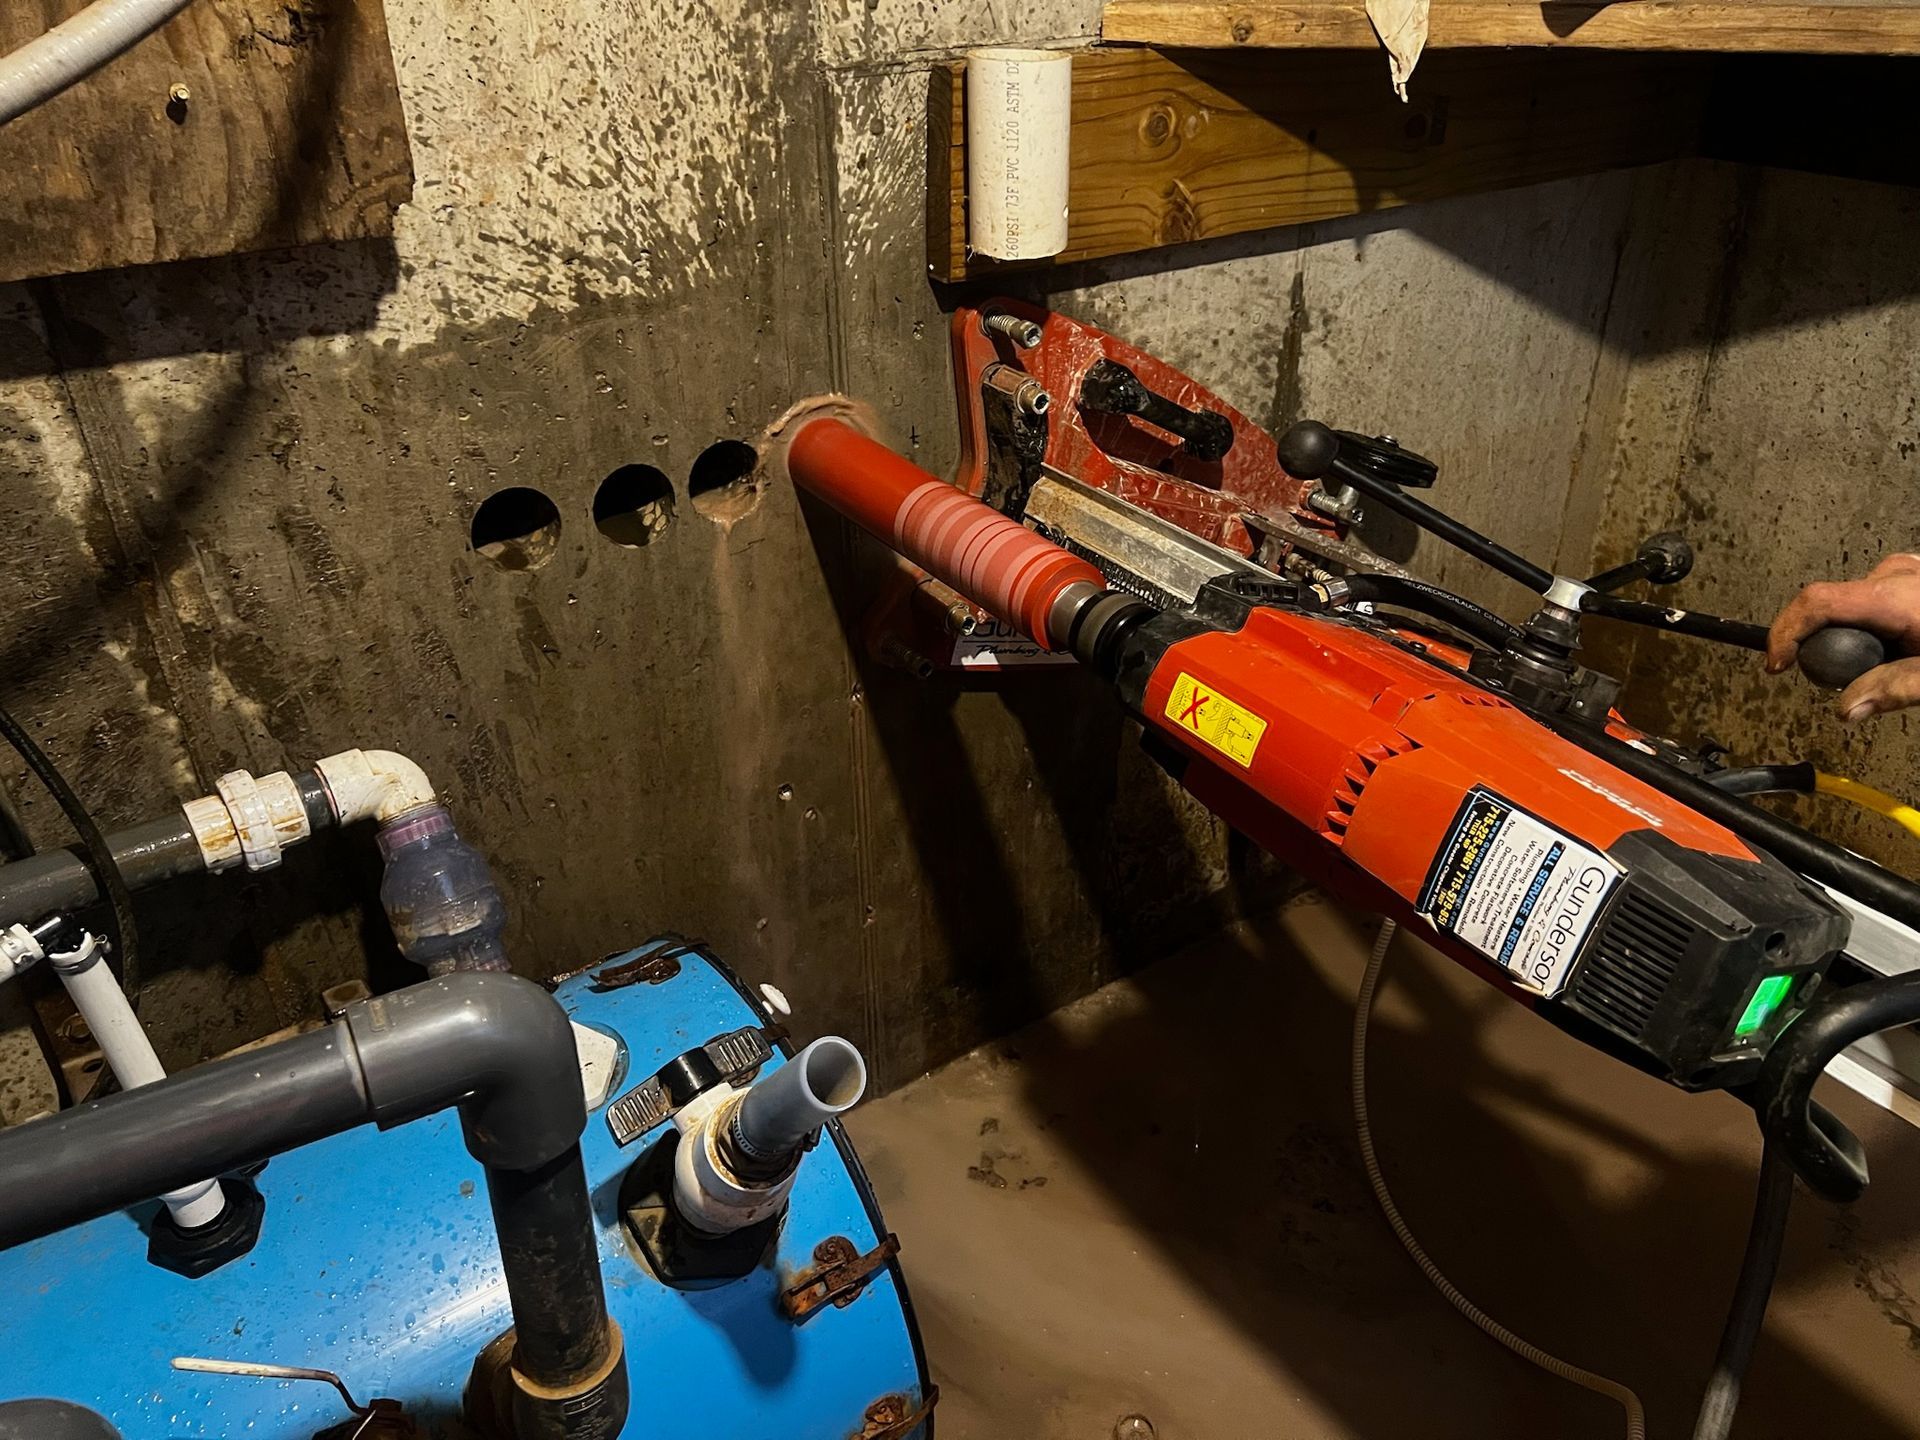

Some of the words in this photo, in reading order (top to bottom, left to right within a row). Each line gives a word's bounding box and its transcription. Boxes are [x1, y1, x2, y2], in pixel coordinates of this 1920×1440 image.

[1006, 82, 1019, 113] ASTM
[1006, 157, 1019, 180] PVC
[1006, 217, 1019, 258] 260PSI
[1460, 806, 1499, 870] 715-225-2861
[1502, 819, 1515, 837] New
[1475, 838, 1504, 888] Construction
[1486, 846, 1511, 887] Decorative
[1519, 842, 1536, 866] Water
[1519, 848, 1543, 883] Plumbing
[1544, 846, 1560, 867] ALL
[1496, 854, 1517, 889] Concrete
[1471, 889, 1489, 923] Concrete
[1480, 867, 1521, 948] Softeners/Treatment
[1480, 891, 1498, 925] Flatwork
[1503, 894, 1519, 918] Water
[1519, 868, 1548, 915] SERVICE
[1544, 866, 1576, 916] Plumbing
[1490, 920, 1506, 950] Heaters
[1514, 917, 1524, 926] &
